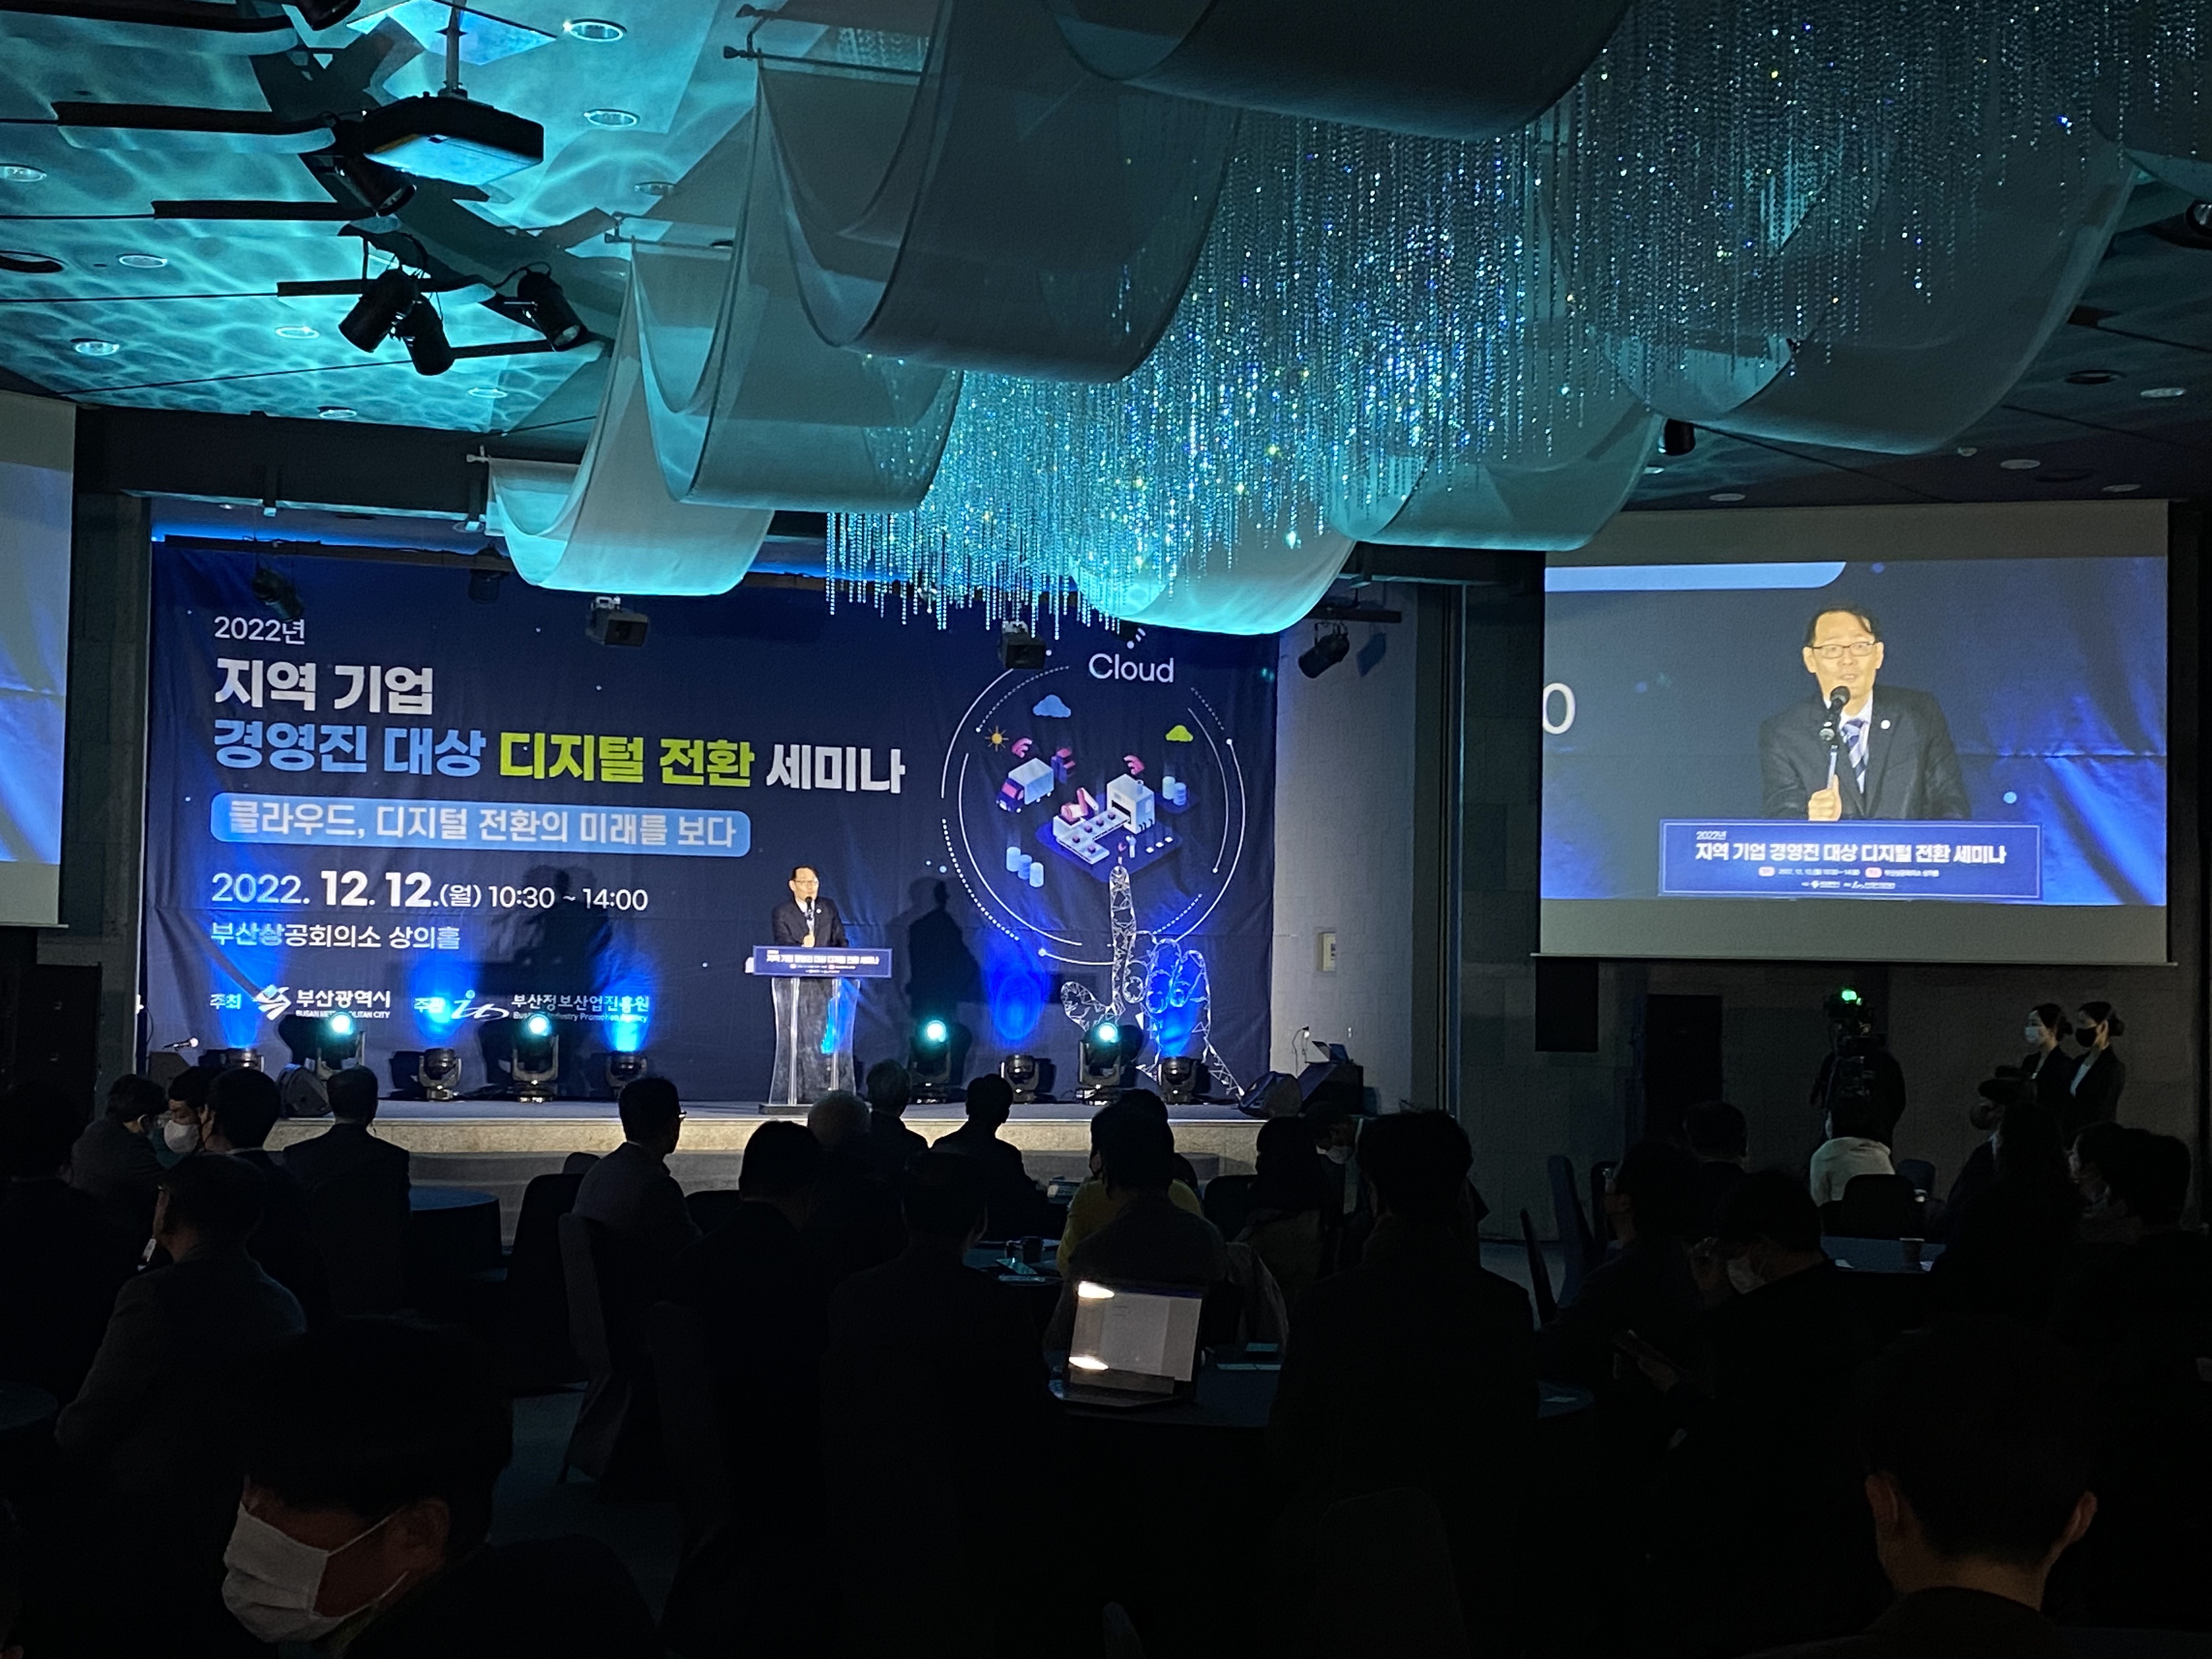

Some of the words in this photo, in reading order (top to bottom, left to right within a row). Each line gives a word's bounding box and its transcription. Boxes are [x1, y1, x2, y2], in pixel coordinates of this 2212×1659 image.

[215, 616, 305, 645] 2022년
[1088, 653, 1174, 682] Cloud
[215, 658, 317, 712] 지역
[334, 665, 433, 715] 기업
[215, 719, 368, 772] 경영진
[384, 727, 486, 777] 대상
[500, 732, 644, 783] 디지털
[659, 739, 755, 787] 전환
[766, 744, 905, 794] 세미나
[230, 801, 365, 838] 클라우드,
[377, 806, 467, 840] 디지털
[479, 809, 568, 843] 전환의
[580, 812, 668, 846] 미래를
[678, 816, 736, 848] 보다
[1695, 843, 1729, 861] 지역
[1733, 843, 1766, 861] 기업
[1770, 843, 1820, 861] 경영진
[1823, 843, 1859, 862] 대상
[1861, 844, 1912, 863] 디지털
[1916, 844, 1951, 863] 전환
[1953, 845, 2007, 864] 세미나
[212, 873, 311, 904] 2022.
[321, 871, 375, 906] 12.
[489, 885, 555, 909] 10:30
[583, 888, 648, 911] 14:00
[211, 922, 381, 948] 부산상공회의소
[389, 927, 460, 949] 상의홀
[210, 994, 242, 1009] 주최
[296, 990, 391, 1008] 부산광역시
[511, 994, 649, 1012] 부산정보산업진흥원
